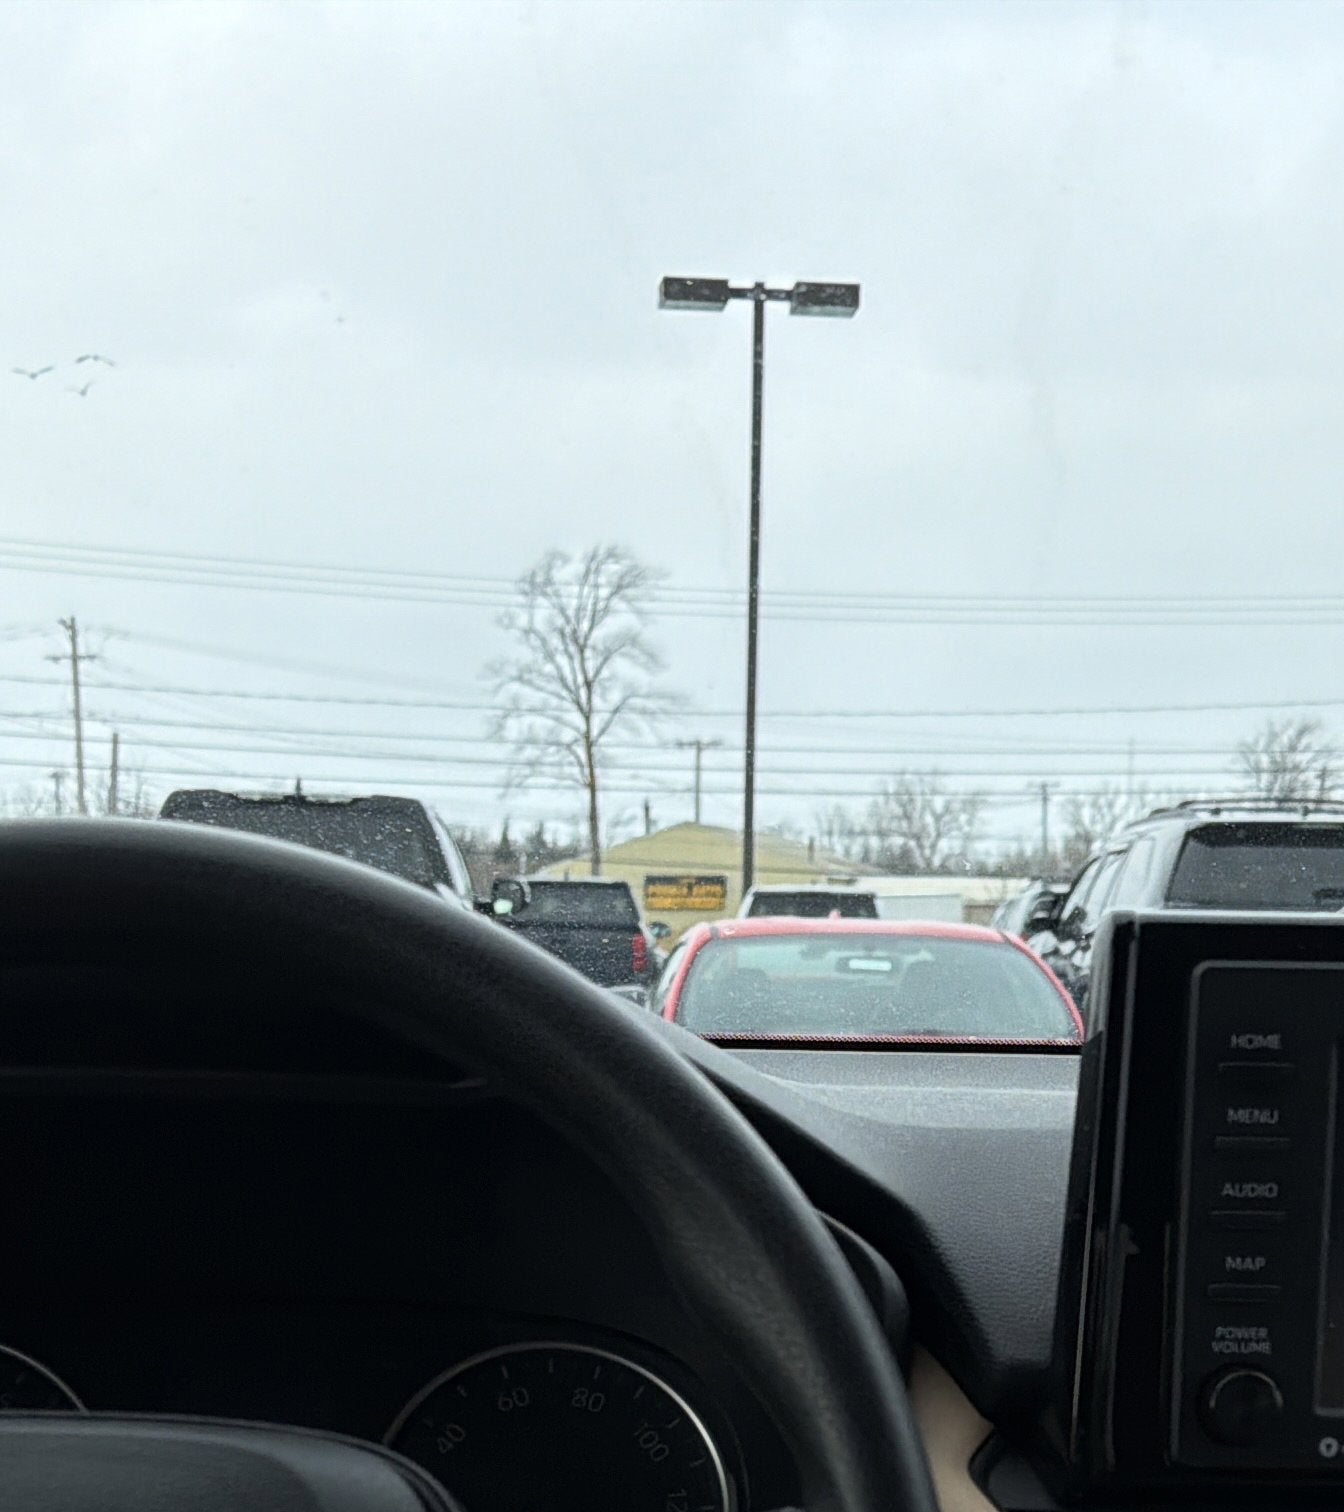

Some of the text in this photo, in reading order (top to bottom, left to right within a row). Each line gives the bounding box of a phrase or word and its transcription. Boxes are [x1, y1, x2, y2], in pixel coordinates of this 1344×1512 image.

[1230, 1033, 1282, 1049] HOME
[1226, 1107, 1279, 1124] MENU
[1221, 1182, 1279, 1198] AUDIO
[1225, 1256, 1266, 1271] MAP
[1215, 1326, 1268, 1340] POWER
[1211, 1340, 1272, 1355] VOLUME
[497, 1387, 530, 1412] 60
[571, 1387, 606, 1413] 80
[436, 1423, 467, 1454] 40
[633, 1421, 670, 1463] 100
